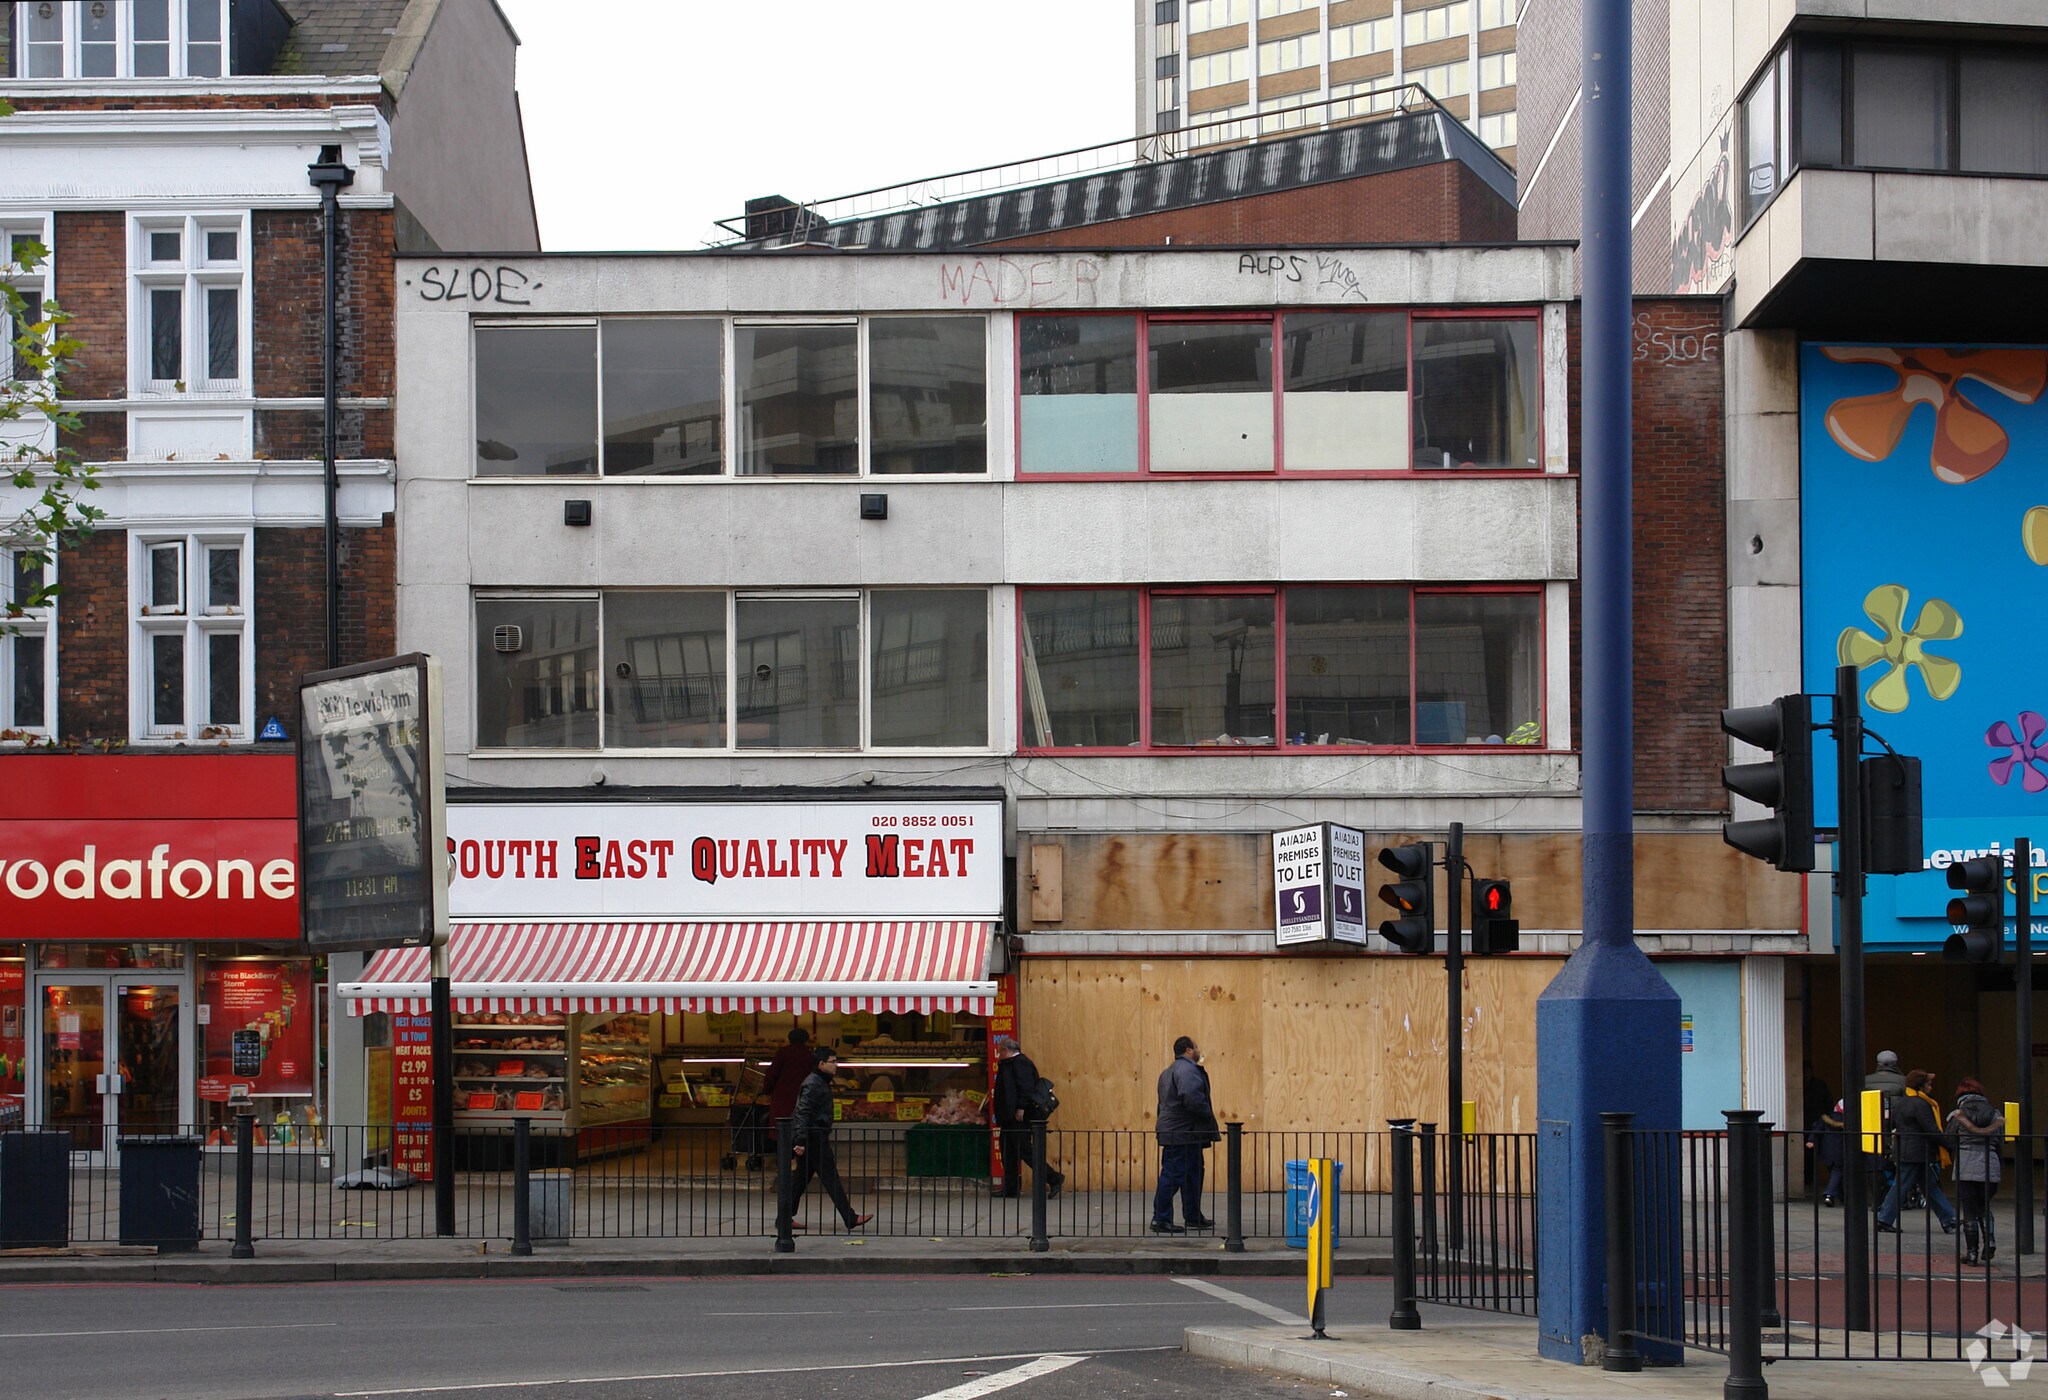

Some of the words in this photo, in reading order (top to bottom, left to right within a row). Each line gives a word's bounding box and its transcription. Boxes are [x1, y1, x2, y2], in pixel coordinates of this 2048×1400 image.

[1239, 254, 1308, 282] ALPS
[346, 689, 411, 718] Lewisham
[872, 816, 897, 827] 020
[902, 815, 937, 827] 8852
[941, 815, 974, 827] 0051
[1279, 831, 1317, 847] A1/A2/A3
[1334, 831, 1359, 846] A1/A2/A3
[447, 836, 558, 879] OUTH
[575, 836, 674, 879] EAST
[691, 836, 848, 885] QUALITY
[866, 834, 974, 877] MEAT
[1278, 847, 1319, 863] PREMISES
[1333, 846, 1360, 862] PREMISES
[1922, 842, 2048, 870] ewish
[0, 844, 295, 900] odafone
[1277, 867, 1294, 883] TO
[1298, 862, 1321, 879] LET
[1333, 862, 1344, 879] TO
[1346, 865, 1361, 882] LET
[345, 878, 376, 897] 11:31
[384, 877, 398, 893] AM
[396, 1017, 409, 1027] BEST
[412, 1017, 431, 1027] PRICES
[401, 1032, 409, 1042] IN
[410, 1032, 427, 1041] TOWN
[396, 1046, 411, 1055] MEAT
[413, 1046, 431, 1055] PACKS
[401, 1061, 427, 1073] £2.99
[399, 1077, 408, 1085] OR
[417, 1077, 429, 1085] FOR
[409, 1088, 422, 1101] £5
[402, 1106, 427, 1116] JOINTS
